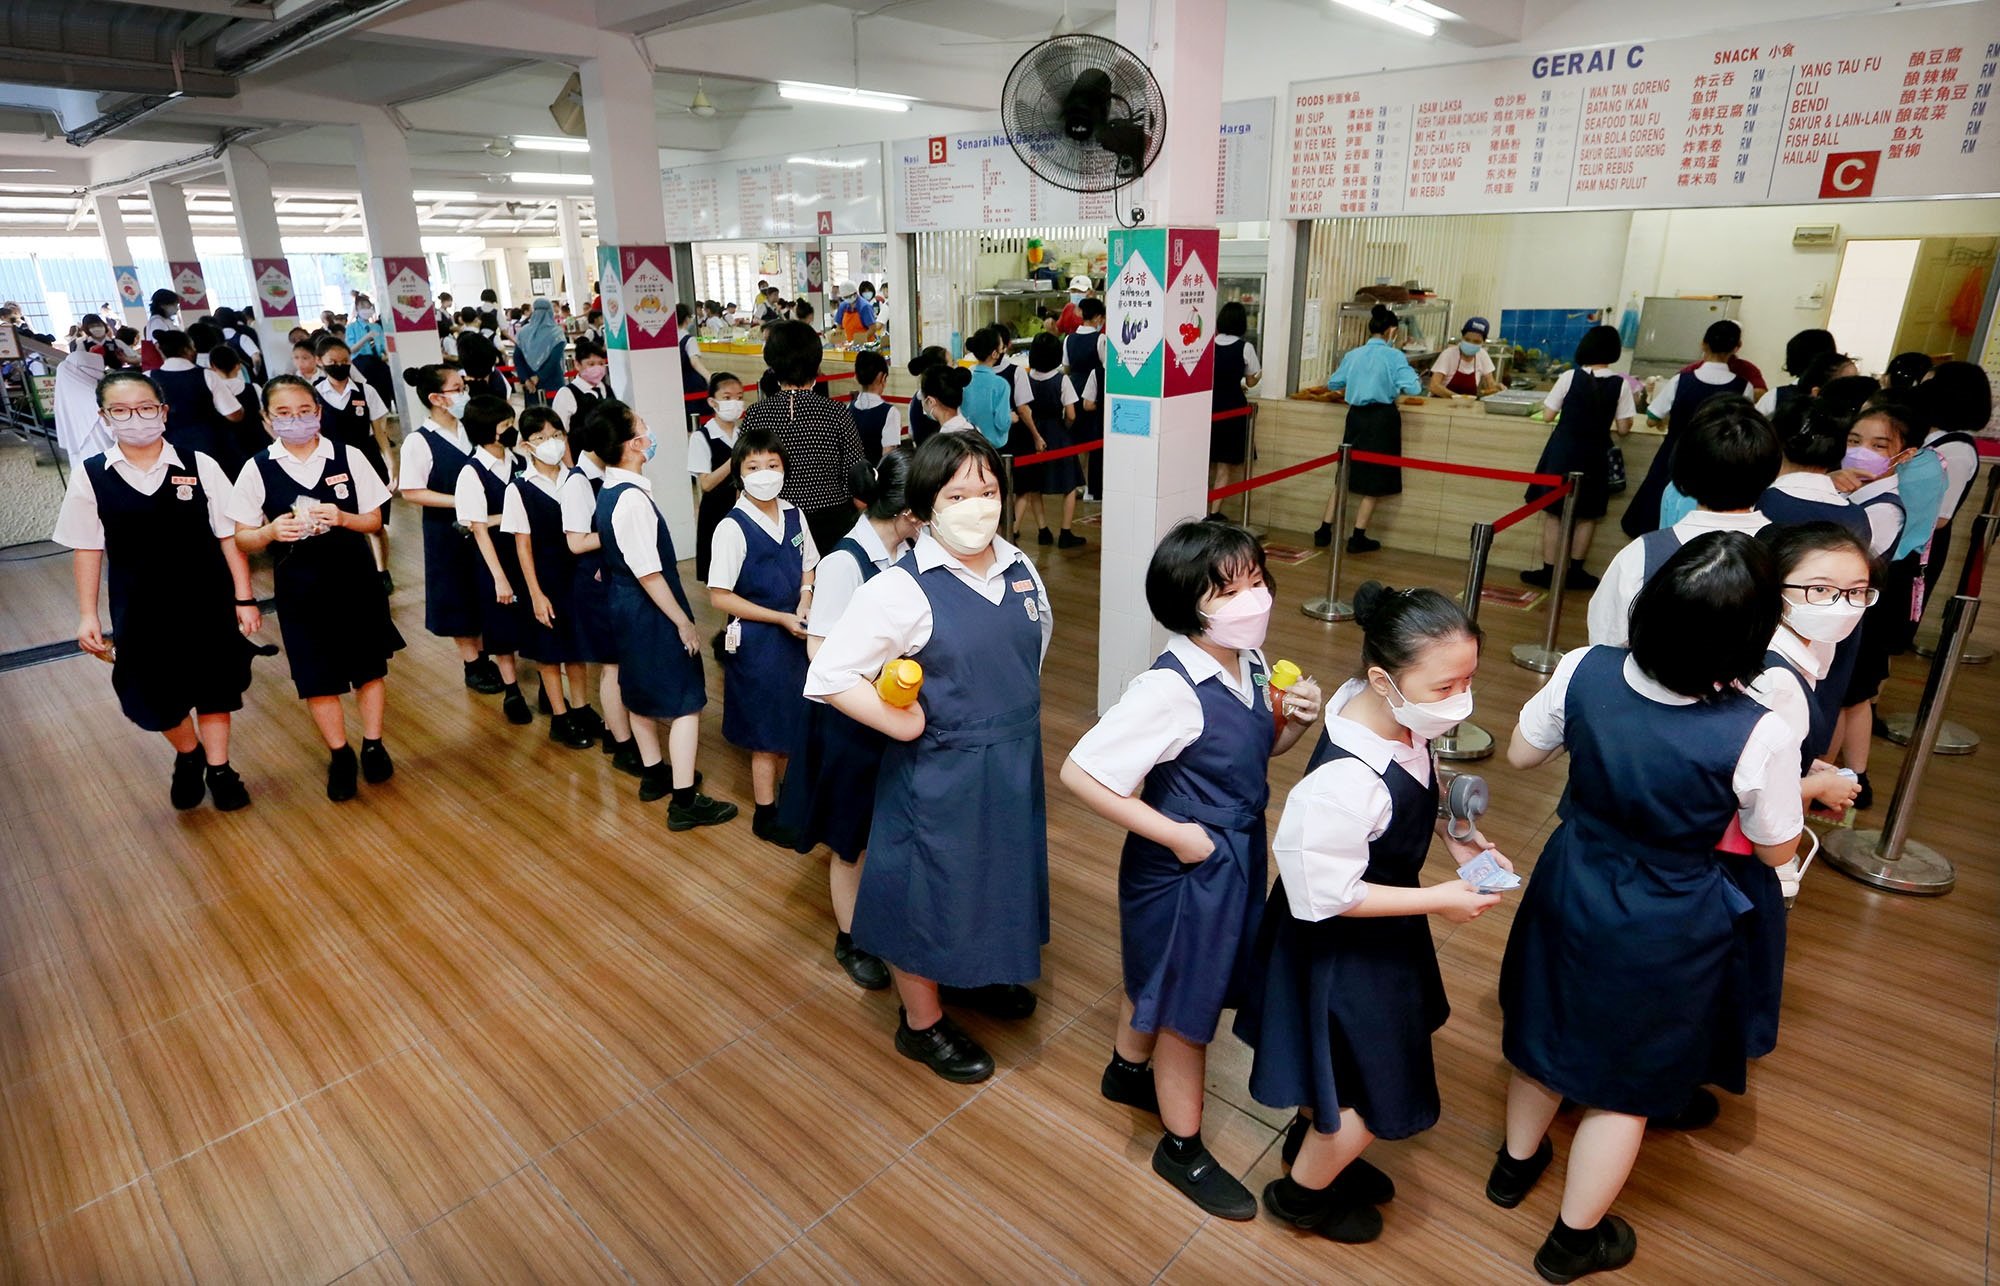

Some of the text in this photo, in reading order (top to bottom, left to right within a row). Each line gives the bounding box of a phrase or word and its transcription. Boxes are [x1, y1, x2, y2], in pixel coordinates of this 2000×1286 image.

[1714, 47, 1759, 64] SNACK
[1769, 43, 1795, 59] 小食
[1909, 47, 1964, 67] 酿豆腐
[1532, 45, 1644, 78] GERAI C
[1801, 56, 1881, 78] YANG TAU FU
[1753, 69, 1765, 82] RM
[1903, 67, 1958, 87] 酿辣椒
[1981, 63, 1996, 79] RM
[1694, 72, 1735, 88] 炸云吞
[1590, 79, 1670, 98] WAN TAN GORENG
[1749, 86, 1762, 99] RM
[1796, 81, 1819, 96] CILI
[1900, 84, 1969, 105] 酿羊角豆
[1975, 83, 1991, 98] RM
[1297, 95, 1324, 107] FOODS
[1419, 100, 1462, 113] ASAM LAKSA
[1586, 98, 1648, 114] BATANG IKAN
[1792, 98, 1829, 113] BENDI
[1689, 104, 1744, 121] 海鲜豆腐
[1746, 104, 1758, 117] RM
[1970, 102, 1986, 117] RM
[1296, 112, 1324, 124] MI SUP
[1585, 112, 1661, 130] SEAFOOD TAU FU
[1789, 110, 1892, 131] SAYUR & LAIN-LAIN
[1220, 123, 1251, 134] Harga
[1295, 126, 1332, 138] MI CINTAN
[1686, 122, 1724, 137] 小炸丸
[1743, 121, 1755, 133] RM
[1891, 125, 1924, 141] 鱼丸
[1966, 121, 1981, 136] RM
[957, 136, 990, 149] Senarai
[1415, 131, 1423, 142] MI
[1426, 131, 1436, 141] HE
[1439, 130, 1446, 140] XI
[1582, 128, 1665, 144] IKAN BOLA GORENG
[1785, 132, 1839, 148] FISH BALL
[932, 141, 943, 160] B
[1294, 138, 1336, 150] MI YEE MEE
[1414, 142, 1471, 156] ZHU CHANG FEN
[1740, 138, 1752, 150] RM
[1888, 143, 1921, 159] 蟹柳
[1961, 140, 1976, 154] RM
[904, 155, 919, 164] Nasi
[1293, 152, 1337, 162] MI WAN TAN
[1580, 144, 1665, 161] SAYUR GELUNG GORENG
[1783, 151, 1819, 164] HAILAU
[1413, 159, 1420, 170] MI
[1423, 159, 1435, 169] SUP
[1737, 154, 1749, 166] RM
[1292, 164, 1334, 175] MI PAN MEE
[1579, 161, 1634, 175] TELUR REBUS
[1833, 158, 1866, 191] C
[1291, 177, 1336, 188] MI POT CLAY
[1411, 171, 1456, 183] MI TOM YAM
[1576, 177, 1647, 191] AYAM NASI PULUT
[1733, 171, 1745, 184] RM
[1290, 191, 1322, 201] MI KICAP
[1410, 186, 1445, 197] MI REBUS
[1289, 203, 1322, 213] MI KARI
[821, 215, 830, 231] A
[1123, 272, 1147, 286] 和谐
[1182, 274, 1204, 288] 新鲜
